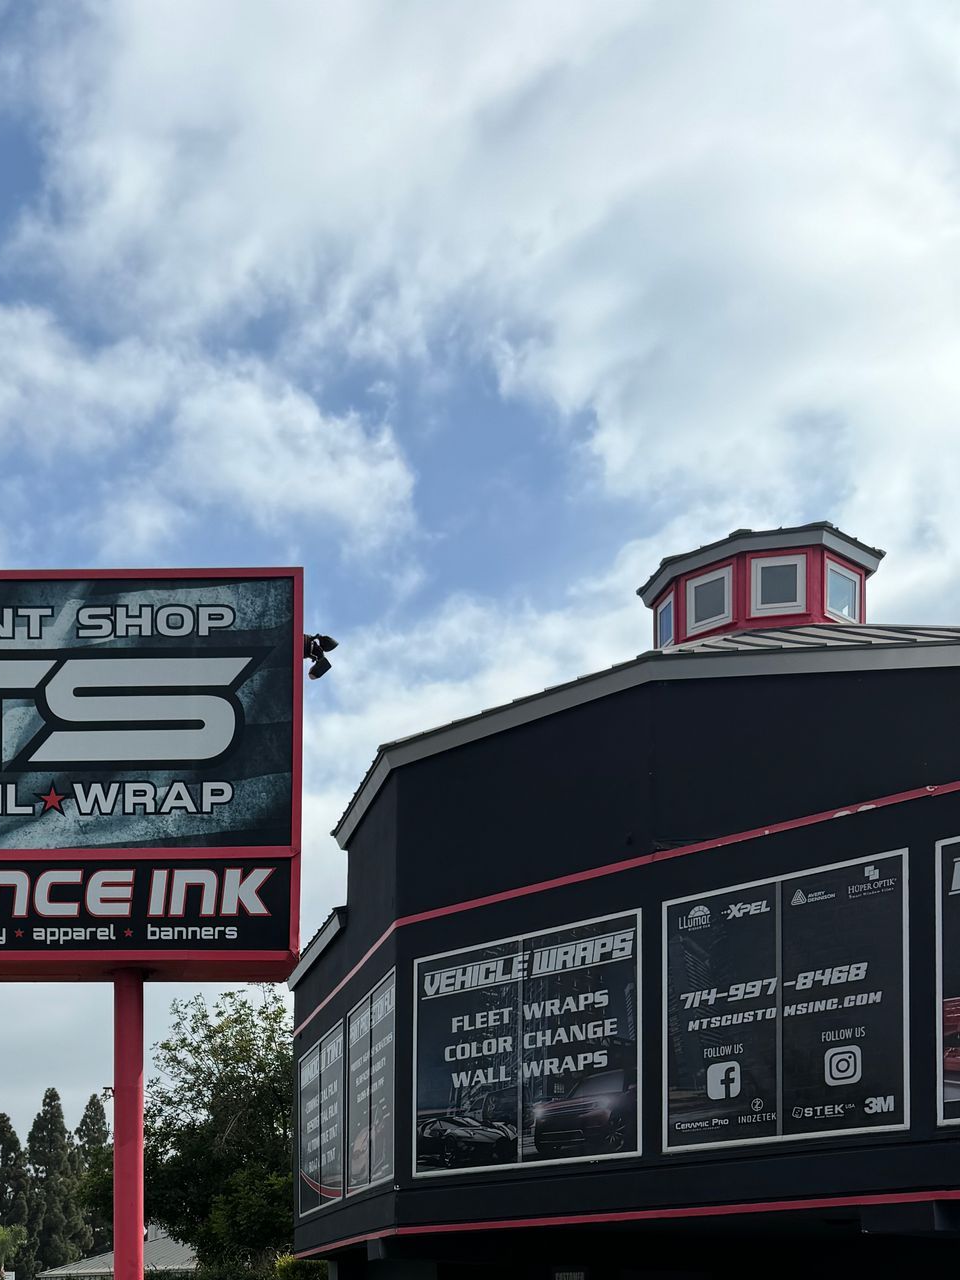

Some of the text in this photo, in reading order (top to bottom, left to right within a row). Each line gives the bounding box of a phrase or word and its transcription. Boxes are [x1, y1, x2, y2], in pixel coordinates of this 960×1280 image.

[76, 606, 235, 638] SHOP
[72, 781, 234, 814] WRAP
[146, 867, 275, 917] INK
[807, 890, 826, 898] AVERY
[726, 900, 771, 920] XPEL
[32, 924, 116, 942] apparel
[147, 924, 238, 941] banners
[424, 931, 634, 996] VEHICLE WRAPS
[451, 989, 609, 1033] FLEET WRAPS
[444, 1018, 618, 1062] COLOR CHANGE
[821, 1026, 866, 1043] FOLLOW US
[703, 1043, 744, 1058] FOLLOW US
[451, 1050, 608, 1088] WALL WRAPS
[804, 1104, 844, 1117] STEK
[864, 1095, 895, 1114] 3M
[738, 1112, 777, 1124] INOZETEK
